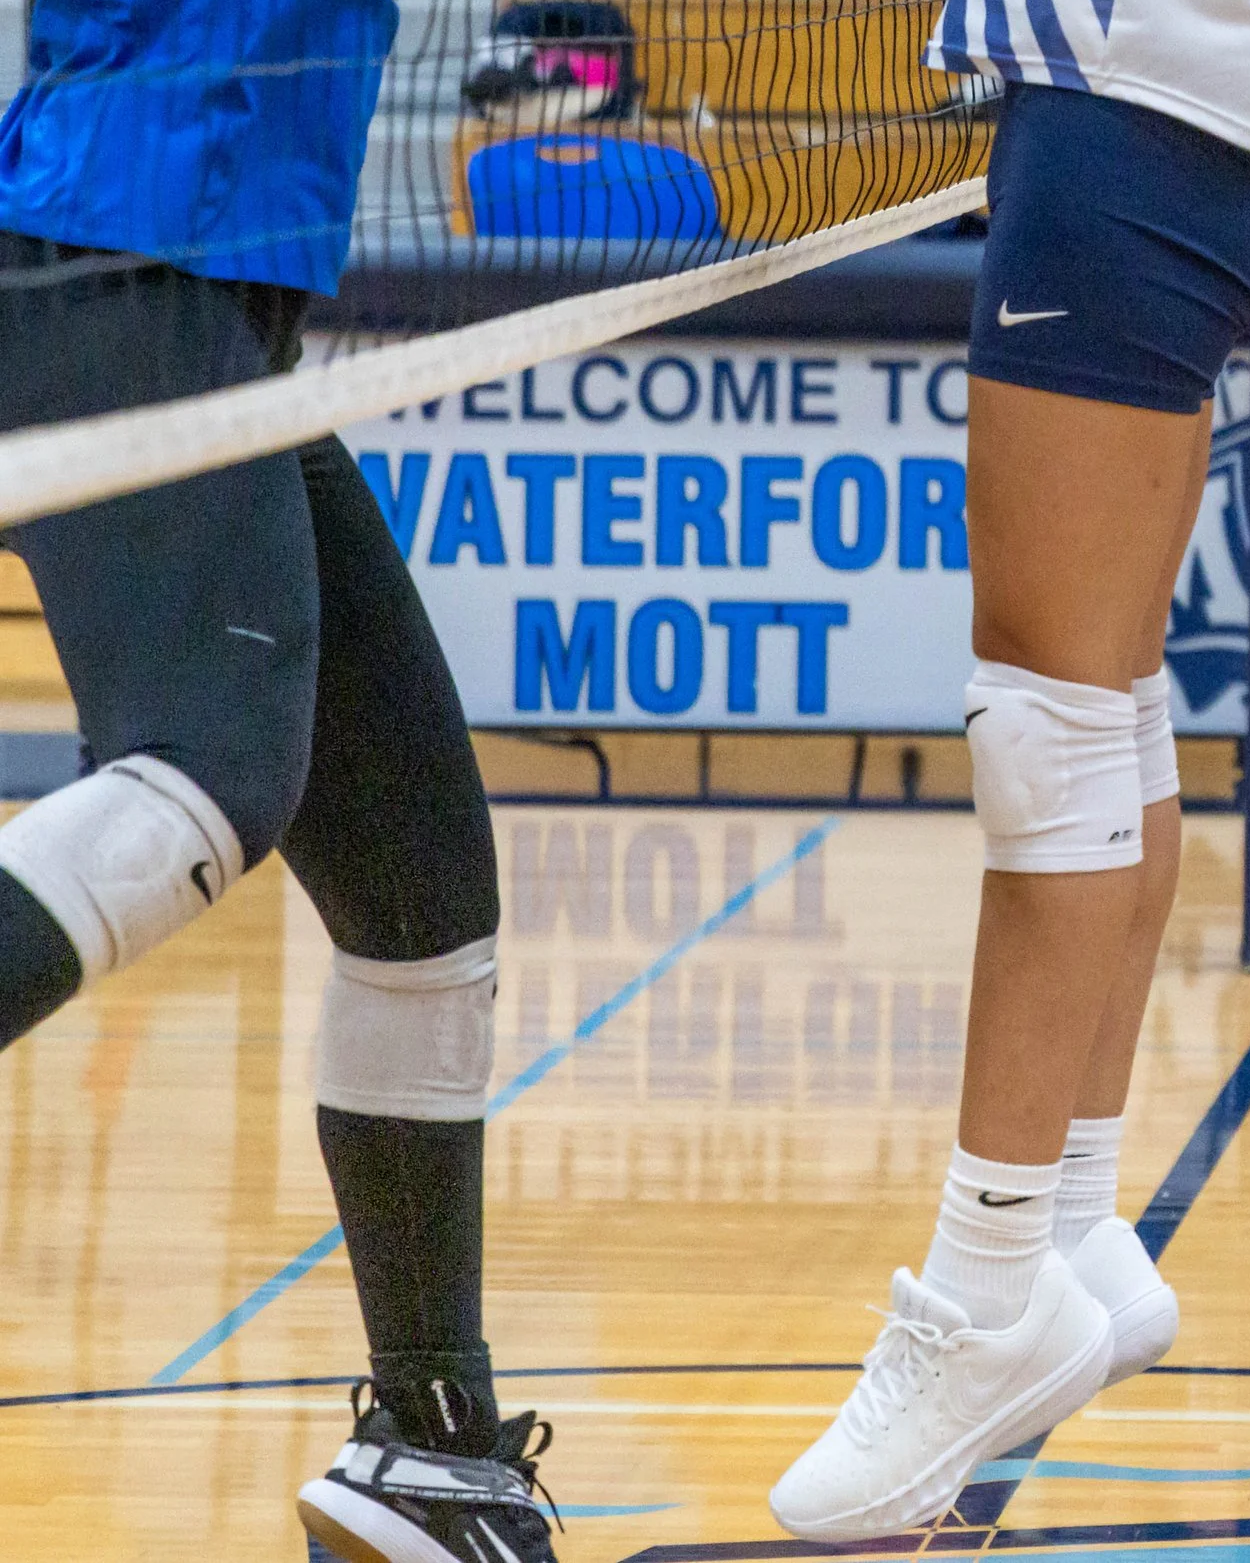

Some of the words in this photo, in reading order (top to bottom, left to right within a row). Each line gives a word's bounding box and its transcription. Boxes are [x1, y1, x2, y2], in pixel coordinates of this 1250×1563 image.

[388, 356, 838, 425] ELCOME
[866, 357, 968, 426] TO
[357, 453, 970, 573] ATERFOR
[514, 597, 850, 715] MOTT
